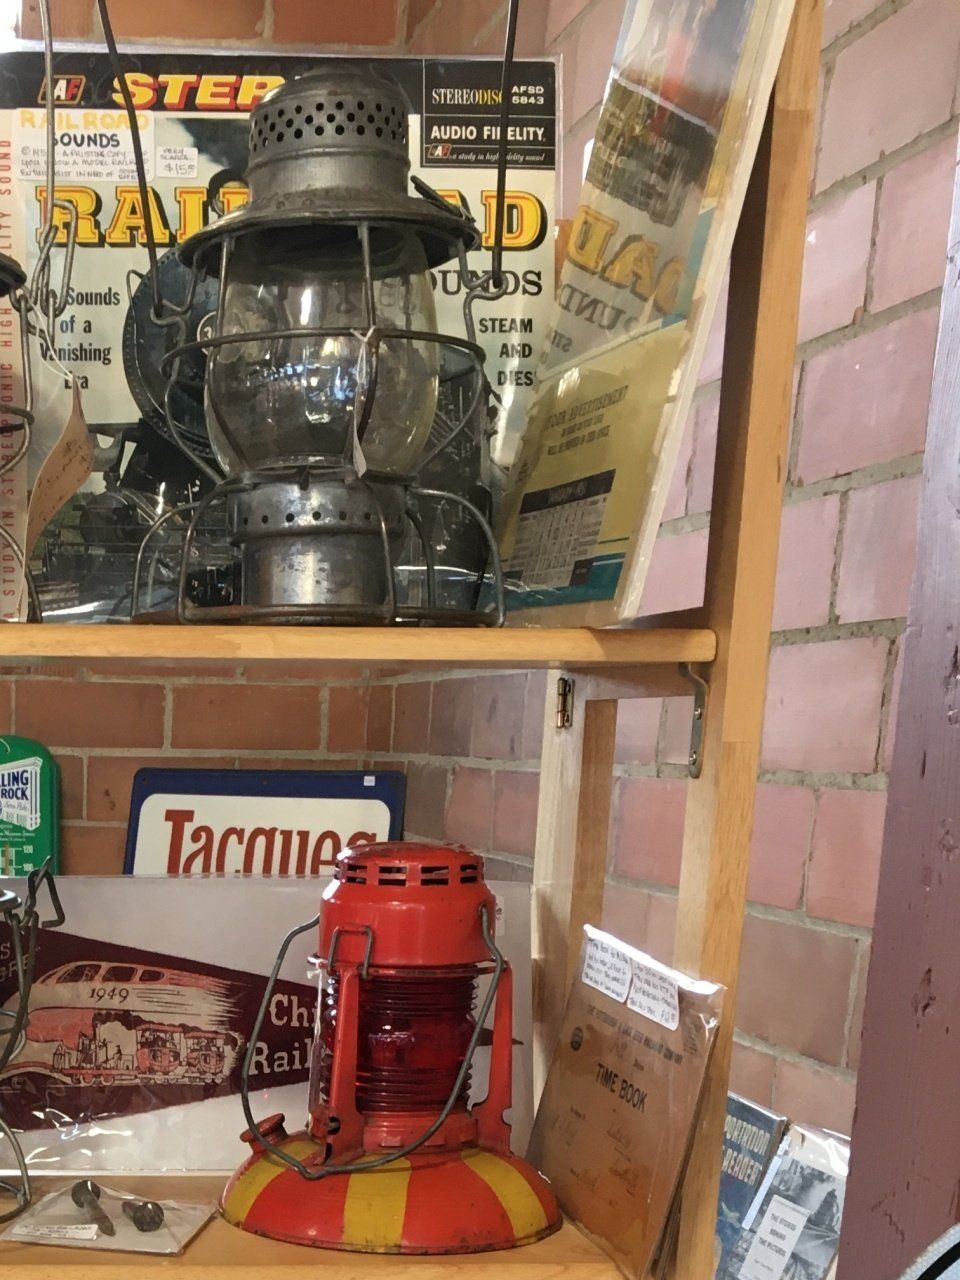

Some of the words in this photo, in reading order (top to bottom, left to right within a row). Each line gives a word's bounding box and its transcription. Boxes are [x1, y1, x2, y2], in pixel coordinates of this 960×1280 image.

[511, 85, 545, 94] AFSD
[511, 95, 545, 105] 5843
[430, 125, 477, 140] AUDIO
[483, 126, 545, 141] FIELITY
[67, 286, 121, 307] Sounds
[0, 307, 13, 348] HIGH
[60, 314, 75, 334] of
[83, 319, 92, 334] a
[478, 317, 533, 334] STEAM
[40, 342, 112, 365] Vanishing
[499, 342, 533, 359] AND
[1, 511, 15, 527] IN
[1, 542, 16, 597] STUDY
[1, 787, 30, 801] ROCK
[88, 987, 130, 1002] 1949
[595, 1063, 619, 1094] TIME
[618, 1078, 648, 1114] BOOK
